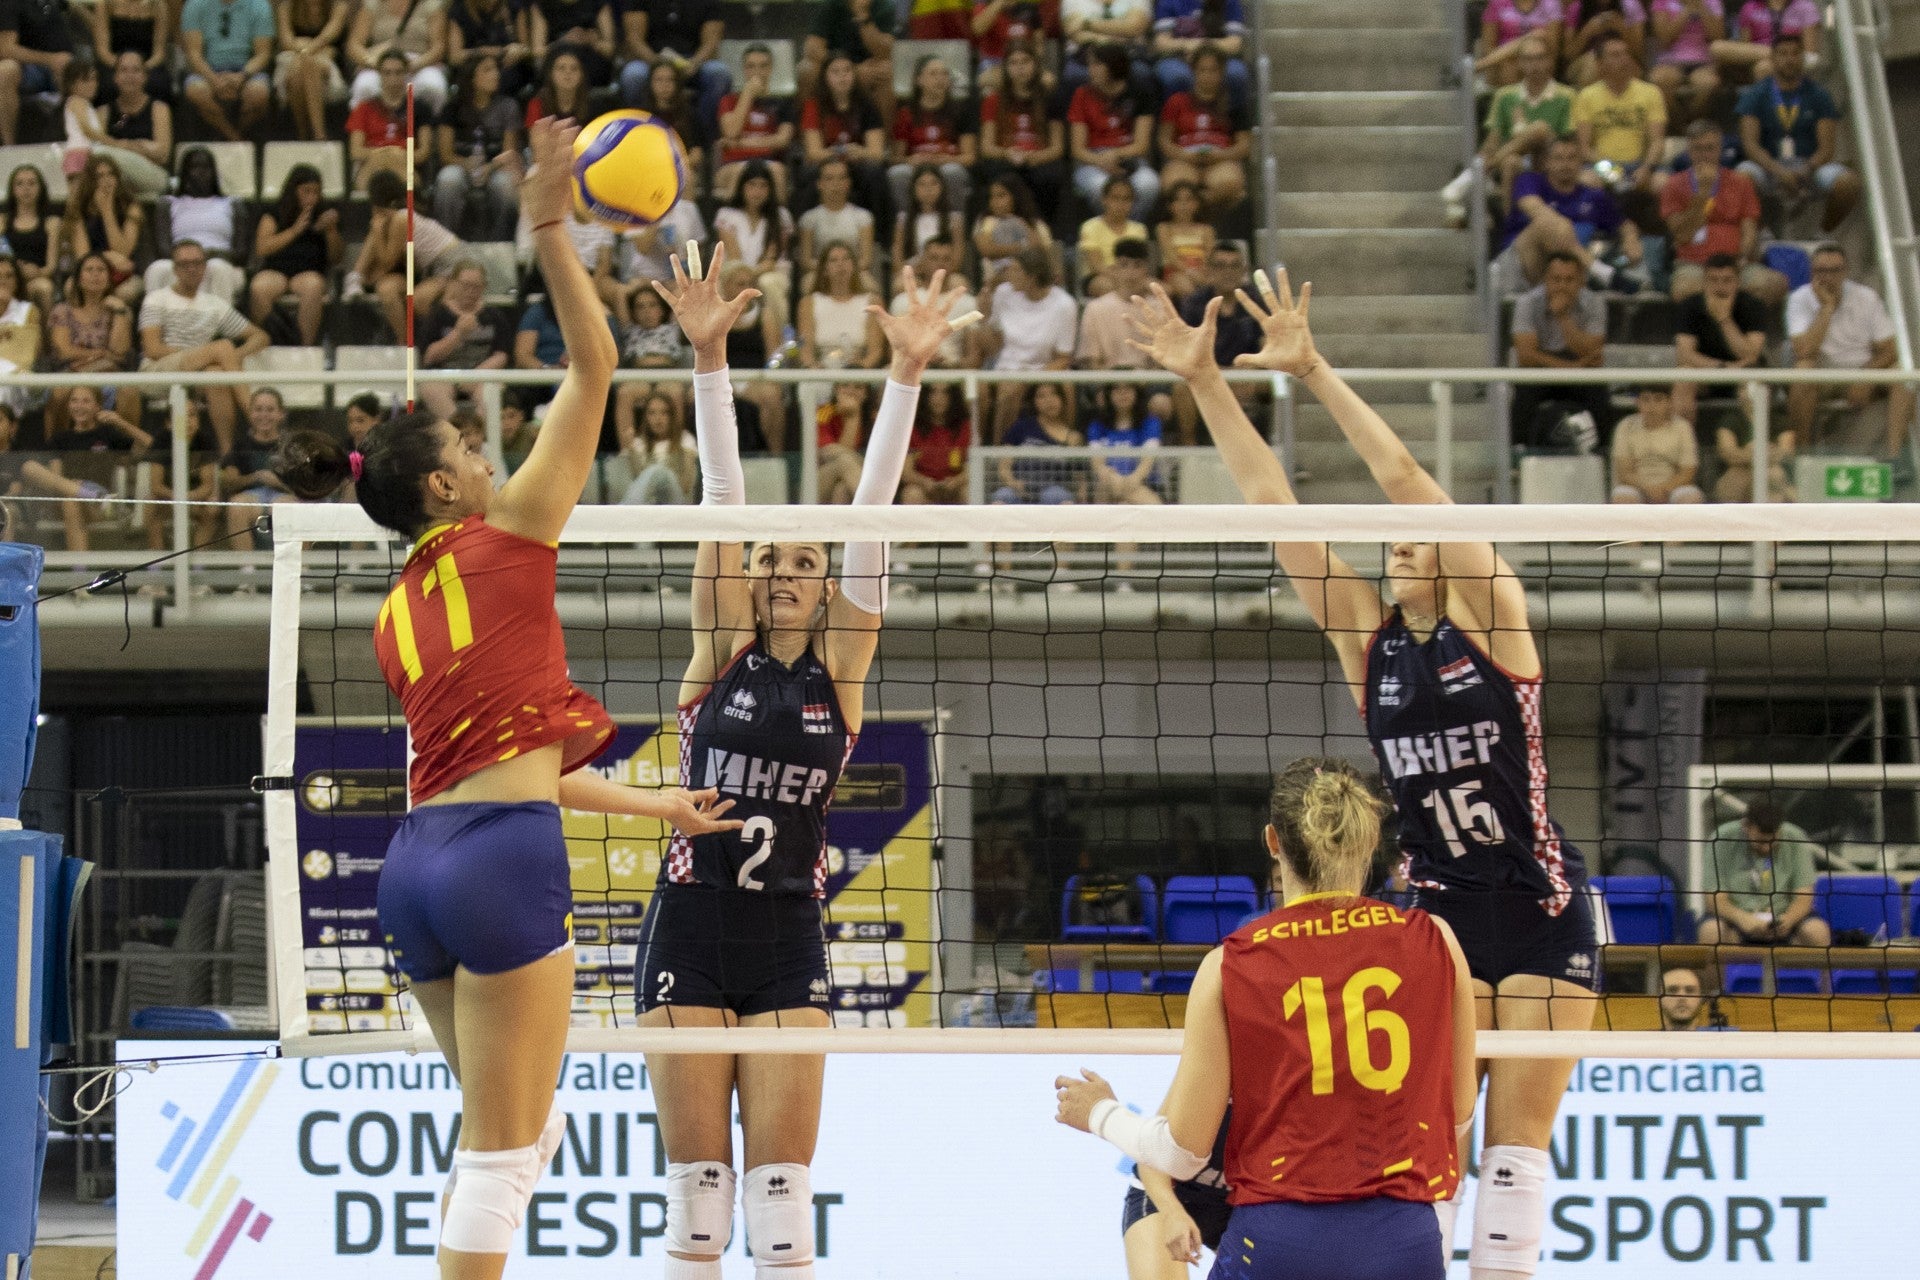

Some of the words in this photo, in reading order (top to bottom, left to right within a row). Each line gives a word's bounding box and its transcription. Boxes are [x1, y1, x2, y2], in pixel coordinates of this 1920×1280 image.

[379, 551, 474, 685] 11
[1421, 780, 1506, 858] 15
[737, 815, 775, 891] 2
[1252, 905, 1407, 943] SCHLEGEL
[656, 970, 675, 1002] 2
[1282, 967, 1411, 1095] 16
[301, 1057, 461, 1091] Comun
[1566, 1059, 1765, 1093] lenciana
